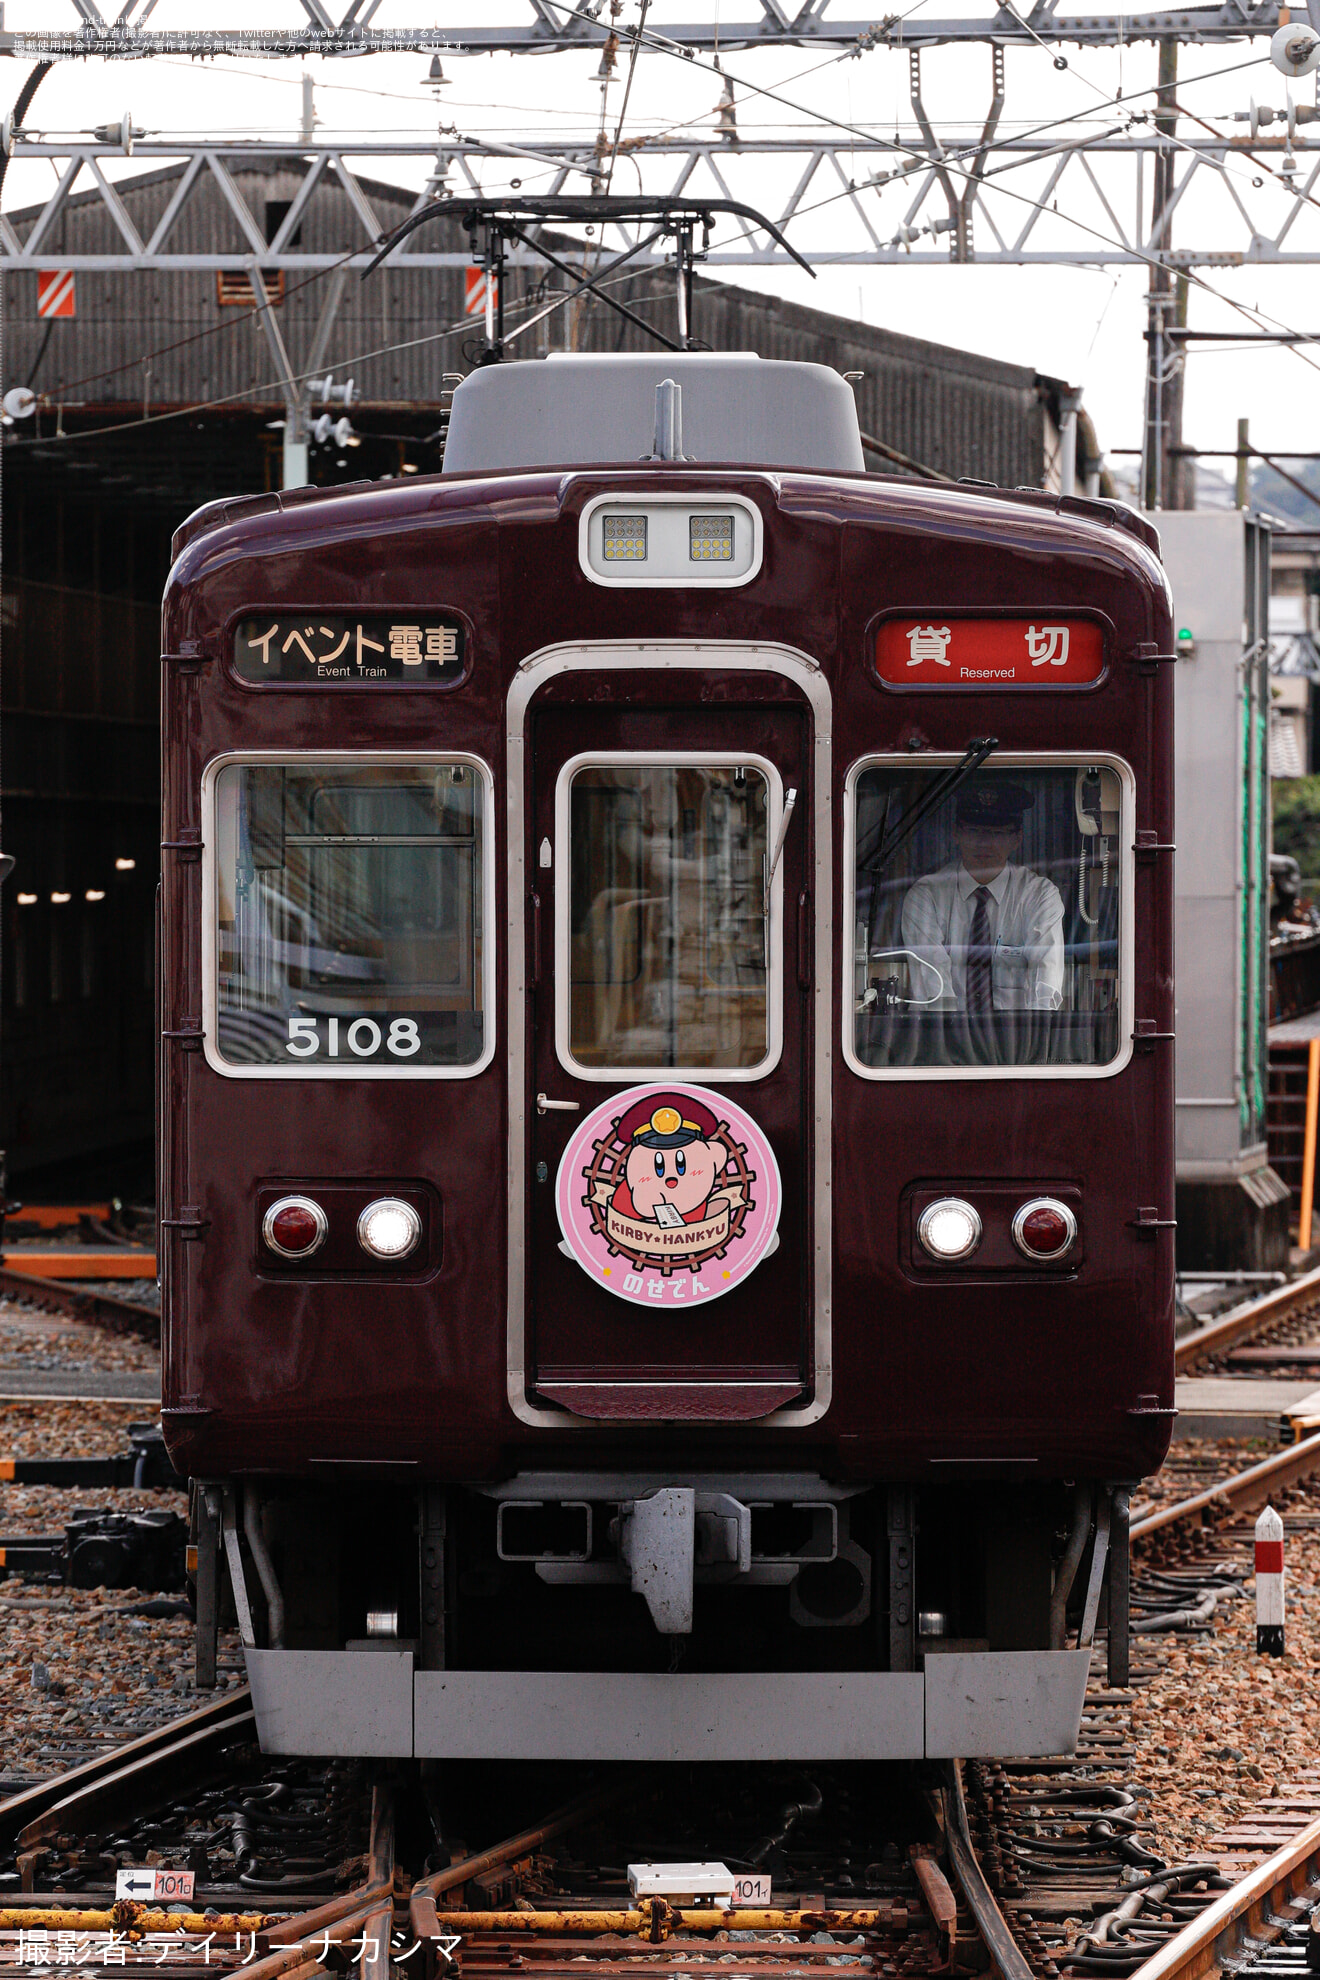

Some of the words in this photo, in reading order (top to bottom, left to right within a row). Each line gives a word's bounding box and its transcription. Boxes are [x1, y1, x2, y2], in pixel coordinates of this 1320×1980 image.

[248, 624, 459, 666] イベント電車
[317, 665, 351, 677] Event
[357, 665, 387, 677] Train
[960, 667, 1015, 679] Reserved
[285, 1017, 422, 1057] 5108
[622, 1273, 710, 1299] のせでん
